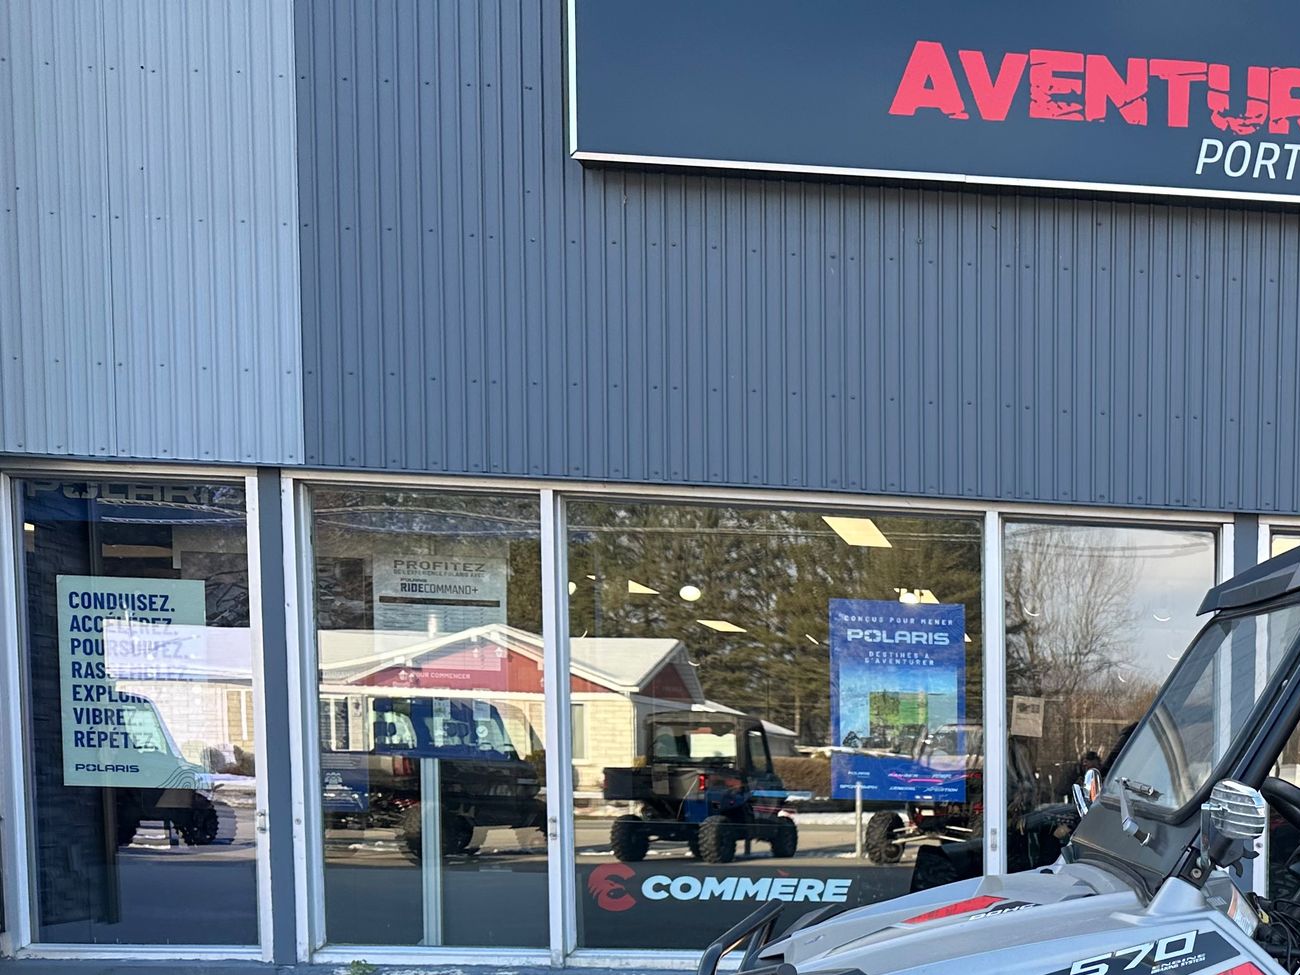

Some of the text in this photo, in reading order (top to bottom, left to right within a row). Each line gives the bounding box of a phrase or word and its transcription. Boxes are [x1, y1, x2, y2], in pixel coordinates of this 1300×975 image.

[393, 560, 487, 572] PROFITEZ
[68, 591, 175, 612] CONDUISEZ.
[846, 628, 950, 646] POLARIS
[75, 763, 140, 773] POLARIS
